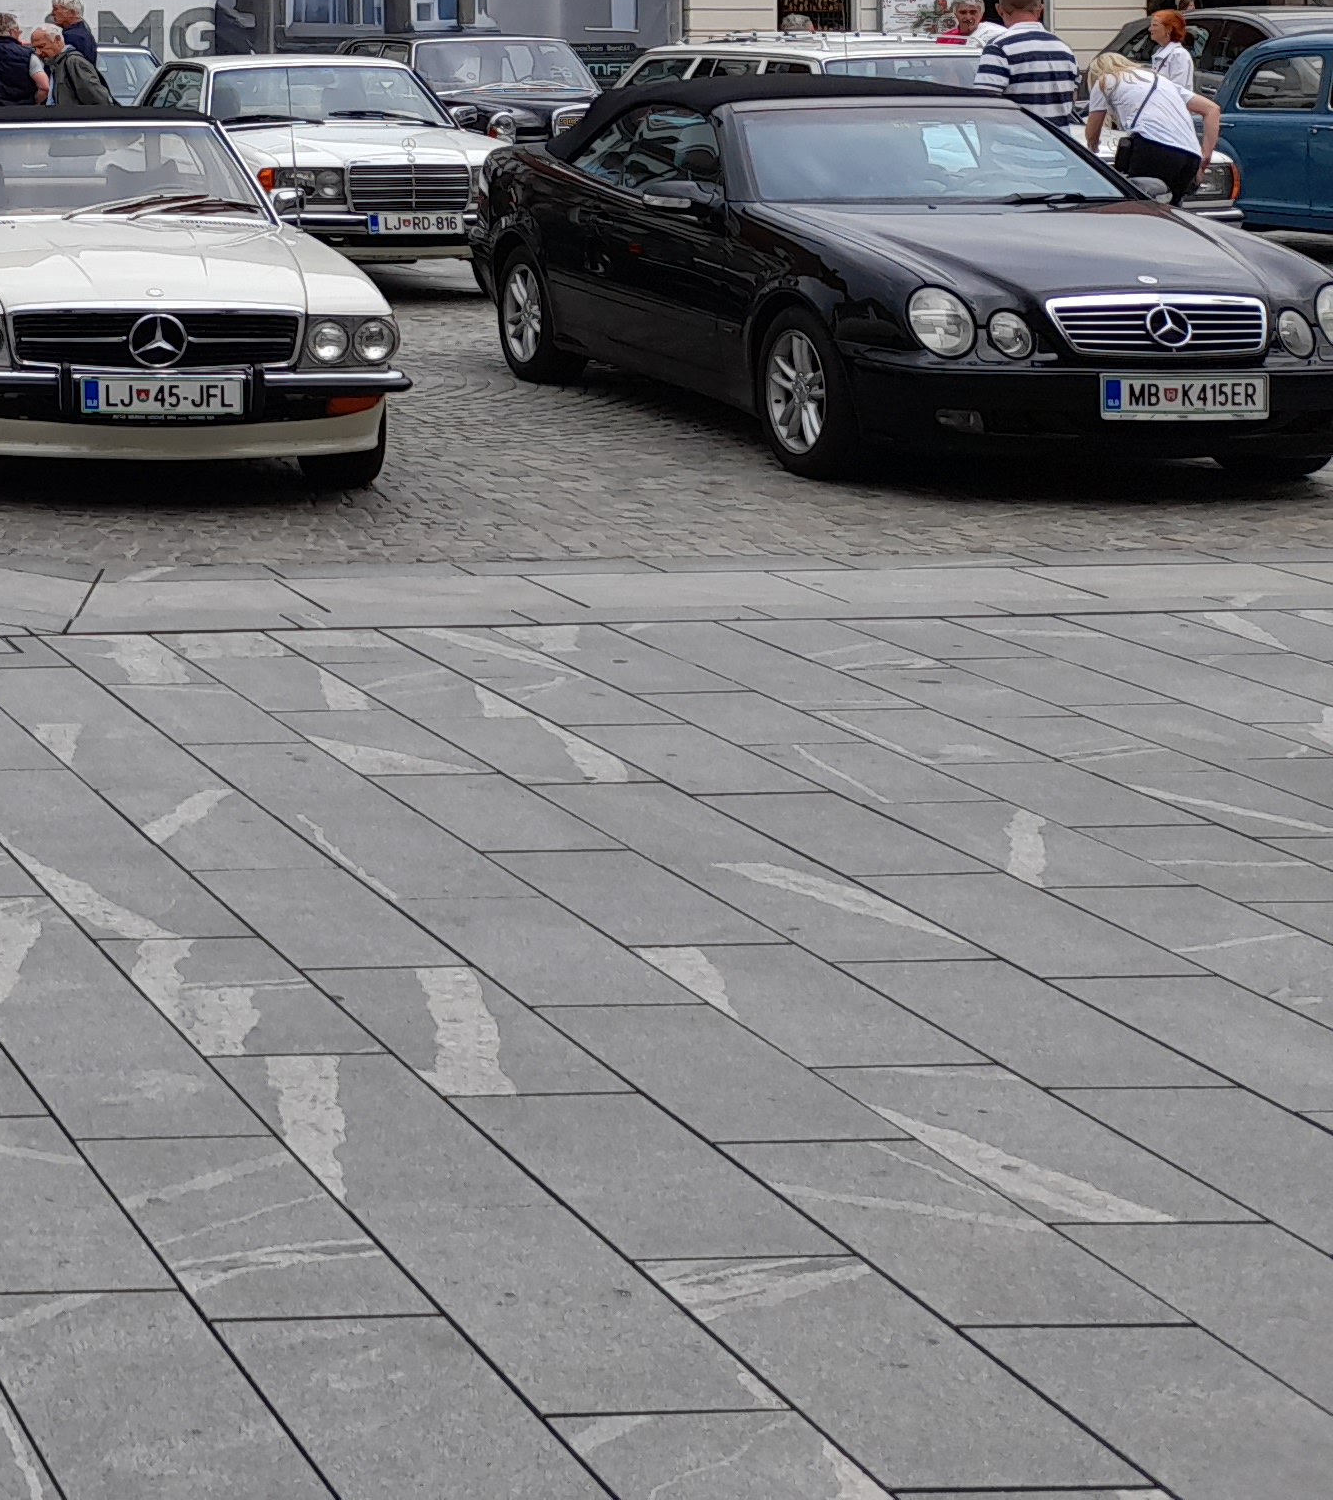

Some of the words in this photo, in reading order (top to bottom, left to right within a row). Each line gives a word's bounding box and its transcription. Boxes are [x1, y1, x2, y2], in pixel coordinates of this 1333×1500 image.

[45, 6, 216, 62] MG
[384, 217, 401, 230] LJ
[412, 216, 458, 231] RD-816
[105, 384, 133, 407] LJ
[153, 384, 234, 408] 45-JFL
[1129, 383, 1160, 406] MB
[1182, 382, 1257, 407] K415ER
